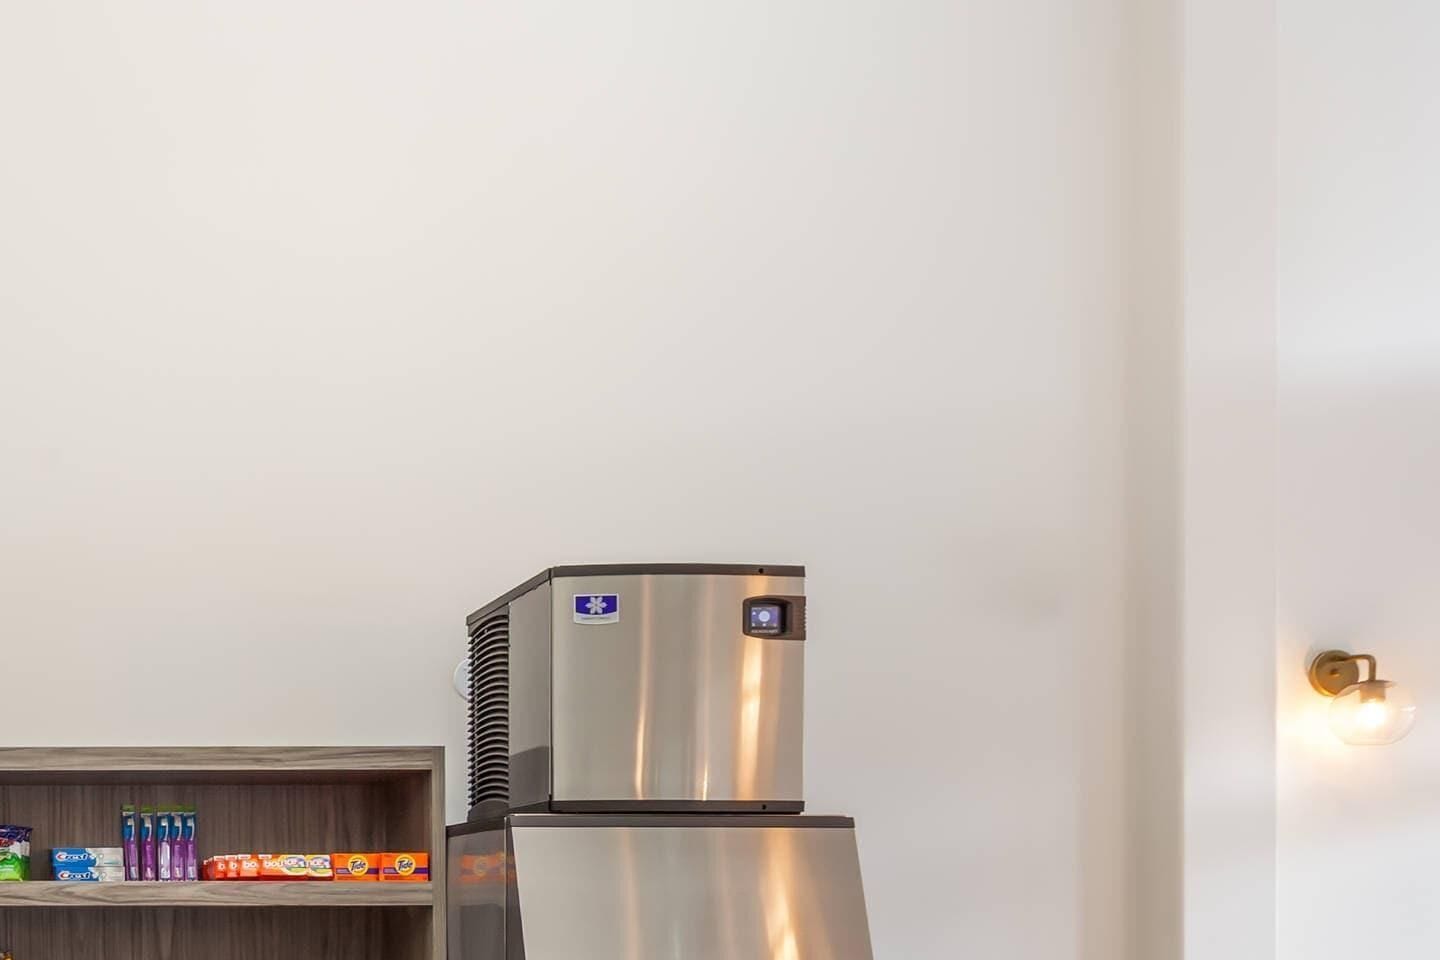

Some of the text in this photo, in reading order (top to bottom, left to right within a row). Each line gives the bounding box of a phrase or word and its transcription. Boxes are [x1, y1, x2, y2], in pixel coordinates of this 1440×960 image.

[56, 852, 88, 861] Crest
[350, 860, 366, 871] Tide
[397, 860, 413, 871] Tide
[58, 871, 90, 880] Crest
